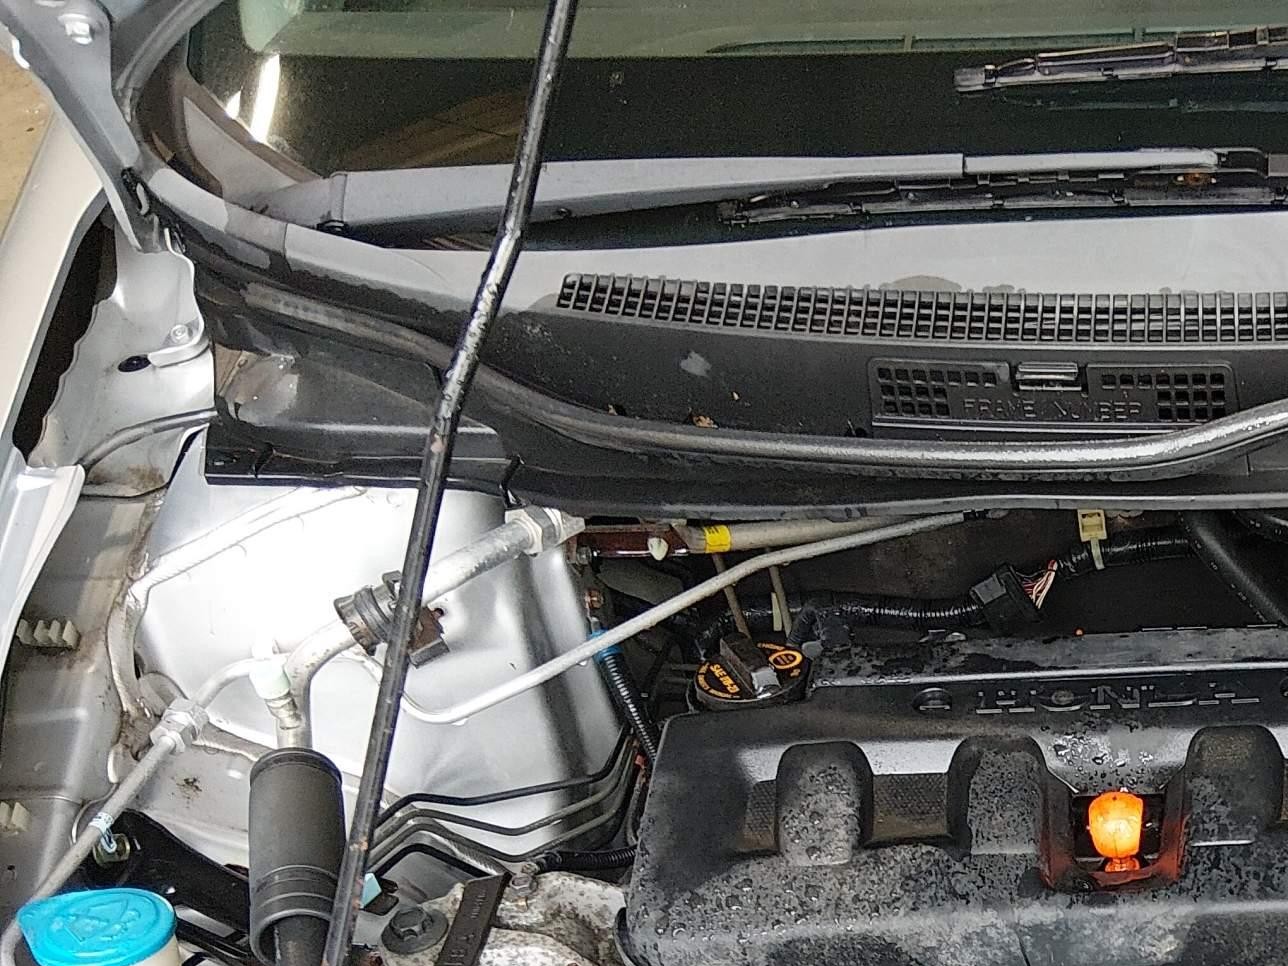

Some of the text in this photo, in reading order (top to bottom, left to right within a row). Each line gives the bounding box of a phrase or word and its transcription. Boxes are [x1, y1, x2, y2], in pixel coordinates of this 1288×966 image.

[964, 398, 1142, 421] FRAME NUMBER
[975, 684, 1260, 714] HONDA
